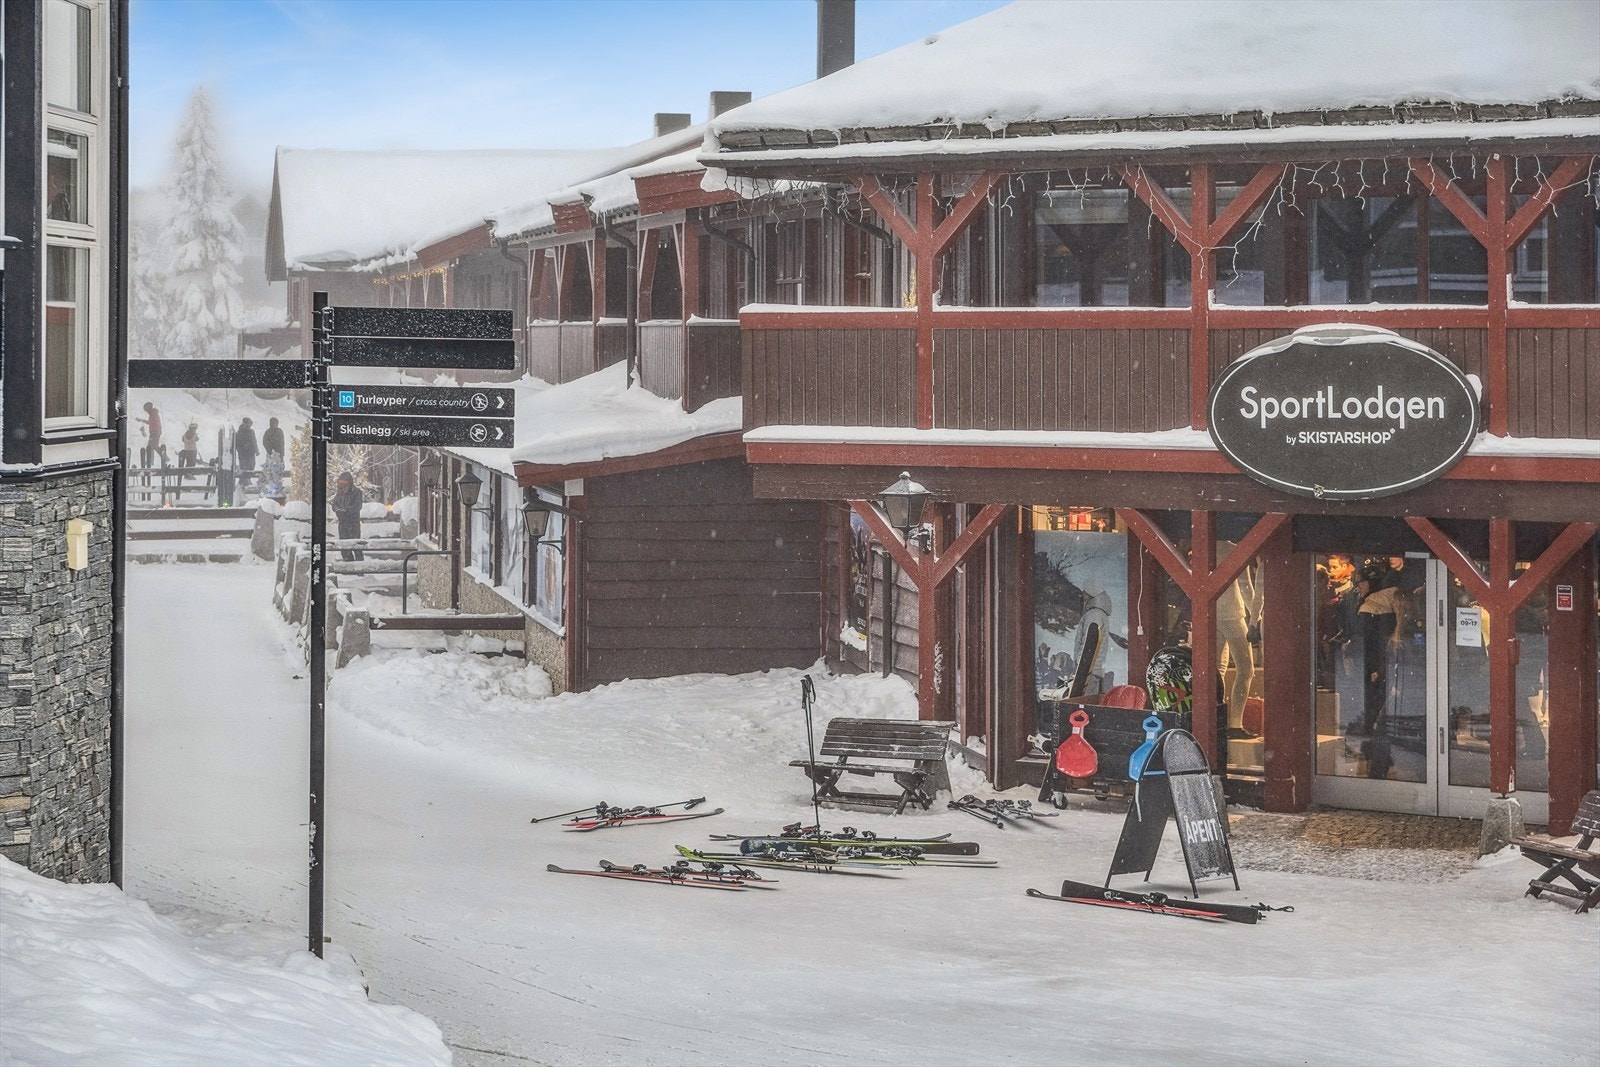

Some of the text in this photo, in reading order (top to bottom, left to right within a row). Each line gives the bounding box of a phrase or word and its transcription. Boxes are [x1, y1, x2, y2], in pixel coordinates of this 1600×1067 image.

[342, 395, 352, 404] 10
[356, 394, 407, 406] Turløyper
[416, 398, 437, 406] cross
[438, 398, 471, 408] country
[340, 424, 392, 437] Skianlegg
[400, 427, 411, 436] ski
[1286, 435, 1297, 446] by
[1184, 815, 1219, 845] ÅPENT
